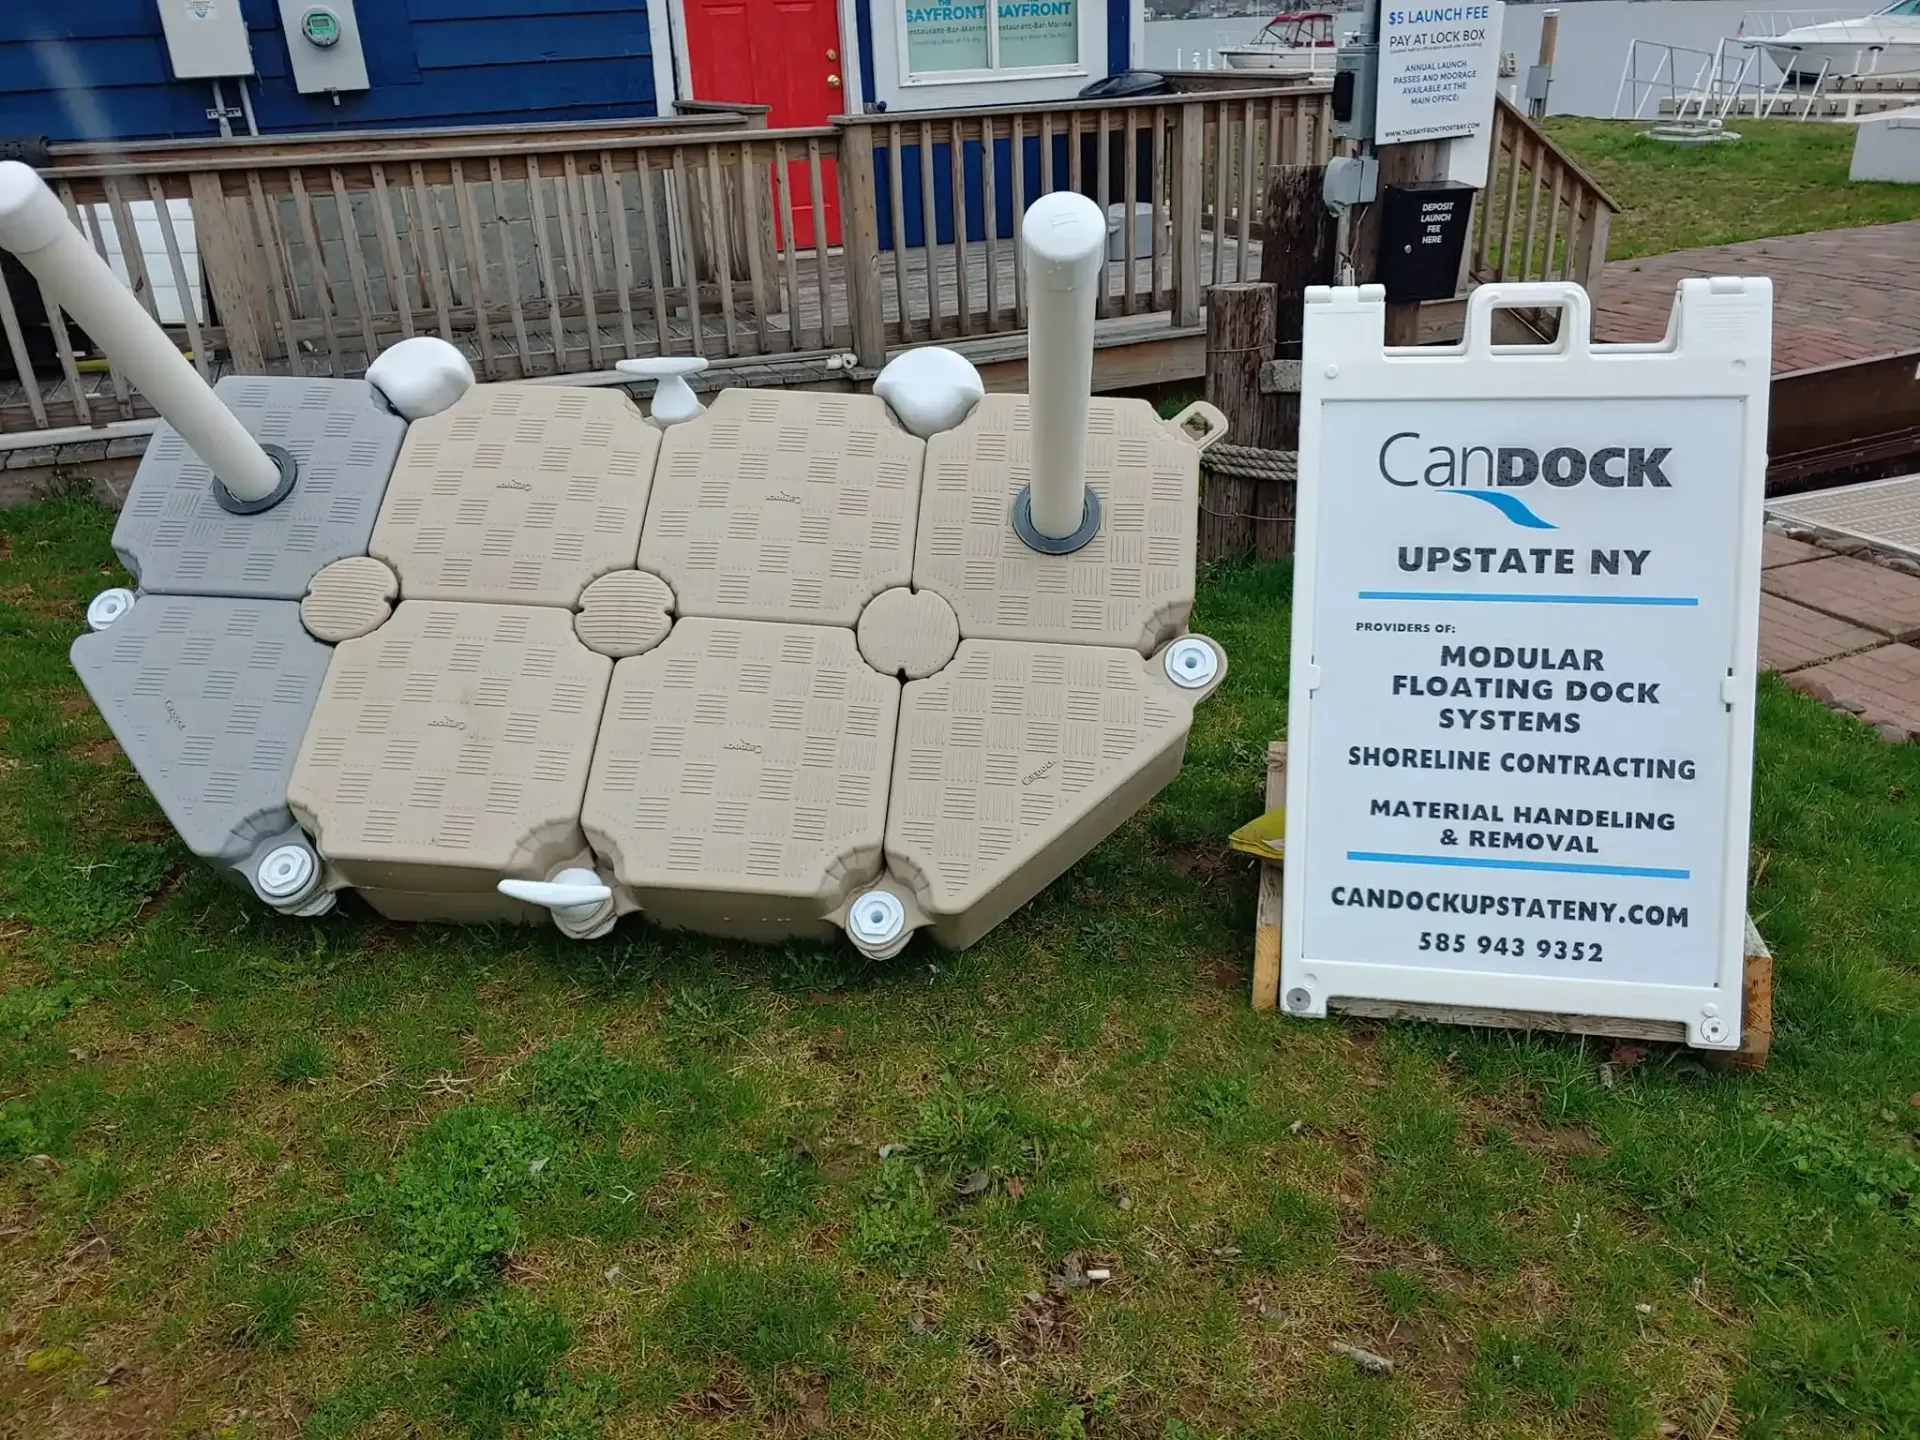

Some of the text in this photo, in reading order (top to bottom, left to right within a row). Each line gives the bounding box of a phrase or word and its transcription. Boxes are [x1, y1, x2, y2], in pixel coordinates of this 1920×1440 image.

[1388, 5, 1489, 25] $5 LAUNCH FEE
[1389, 29, 1486, 48] PAY AT LOCK BOX
[1405, 60, 1467, 72] ANNUAL LAUNCH
[1393, 70, 1477, 84] PASSES AND MOORAGE
[1402, 82, 1467, 95] AVAILABLE AT THE
[1411, 97, 1430, 105] MAIN
[1422, 202, 1454, 212] DEPOSIT
[1421, 213, 1452, 223] LAUNCH
[1427, 225, 1442, 233] FEE
[1422, 235, 1443, 244] HERE
[1399, 547, 1651, 575] UPSTATE NY
[1356, 623, 1455, 633] PROVIDERS OF:
[1441, 646, 1604, 671] MODULAR
[1393, 676, 1660, 703] FLOATING DOCK
[1440, 709, 1580, 733] SYSTEMS
[1349, 746, 1695, 779] SHORELINE CONTRACTING
[1371, 800, 1674, 830] MATERIAL HANDELING
[1440, 829, 1598, 853] & REMOVAL
[1332, 887, 1687, 927] CANDOCKUPSTATENY.COM
[1419, 932, 1602, 962] 585 943 9352
